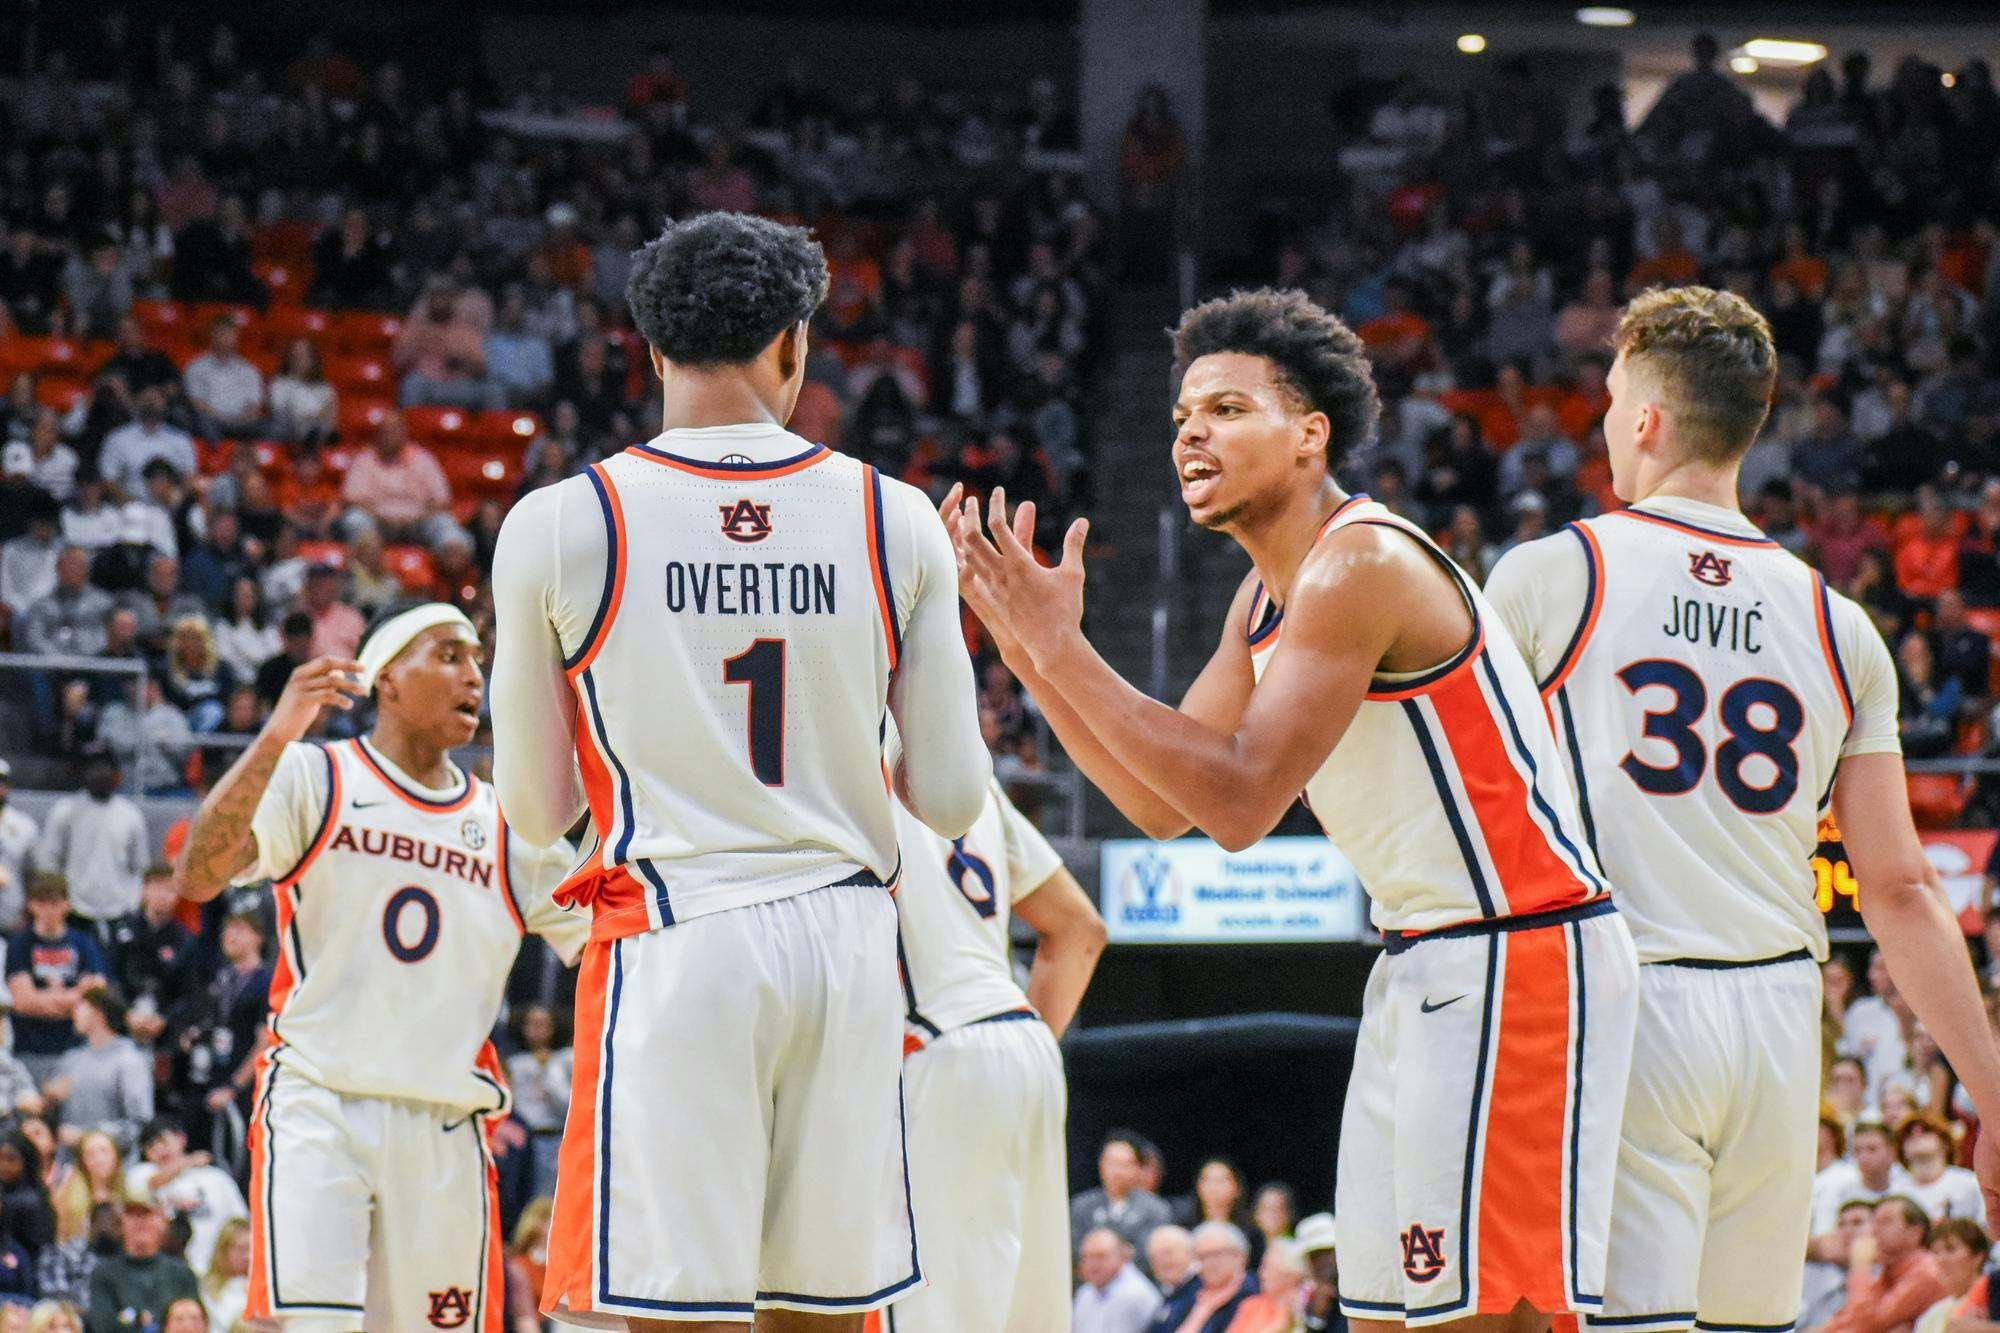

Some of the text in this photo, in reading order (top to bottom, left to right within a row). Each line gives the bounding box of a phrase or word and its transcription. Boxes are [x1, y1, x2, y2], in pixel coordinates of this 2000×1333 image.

[666, 561, 836, 615] OVERTON
[1663, 595, 1763, 654] JOVIĆ
[723, 637, 786, 788] 1
[1615, 657, 1806, 816] 38
[329, 824, 495, 890] AUBURN
[381, 883, 442, 964] 0
